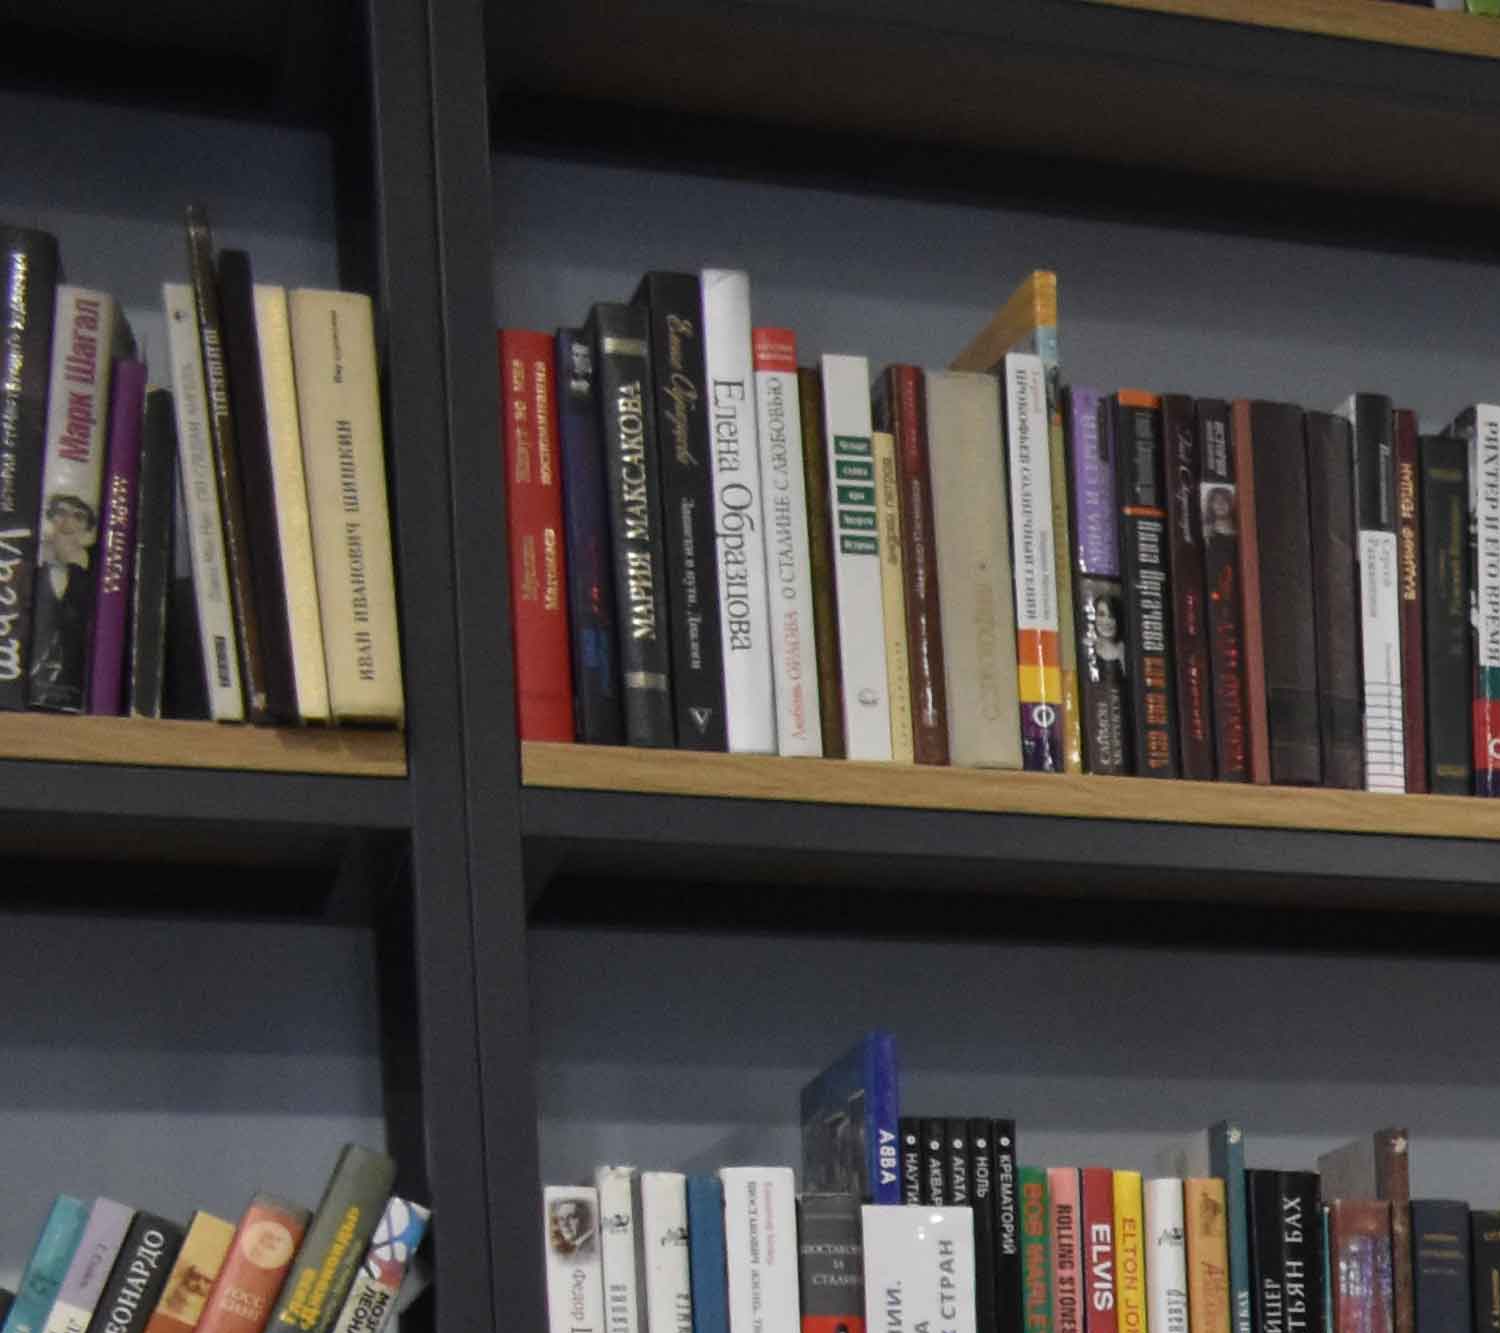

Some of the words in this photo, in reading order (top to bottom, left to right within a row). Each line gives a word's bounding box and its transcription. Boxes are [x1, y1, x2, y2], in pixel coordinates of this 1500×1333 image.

[65, 296, 101, 372] Шагал
[58, 379, 92, 463] Марк
[617, 381, 650, 540] МАКСАКОВА
[712, 378, 745, 473] Елена
[336, 419, 360, 513] ШИШКИН
[628, 552, 656, 640] МАРИЯ
[719, 483, 755, 651] Образцова
[357, 630, 376, 682] ИВАН
[976, 1156, 989, 1197] НОЛЬ
[999, 1155, 1015, 1254] КРЕМАТОРИЙ
[1023, 1184, 1043, 1236] BOB
[1056, 1204, 1075, 1271] ROLLING
[1122, 1217, 1139, 1290] ELTON
[1282, 1196, 1301, 1243] БАХ
[938, 1239, 956, 1321] СТРАН
[1092, 1224, 1113, 1312] ELVIS
[1238, 1290, 1248, 1316] БАХ
